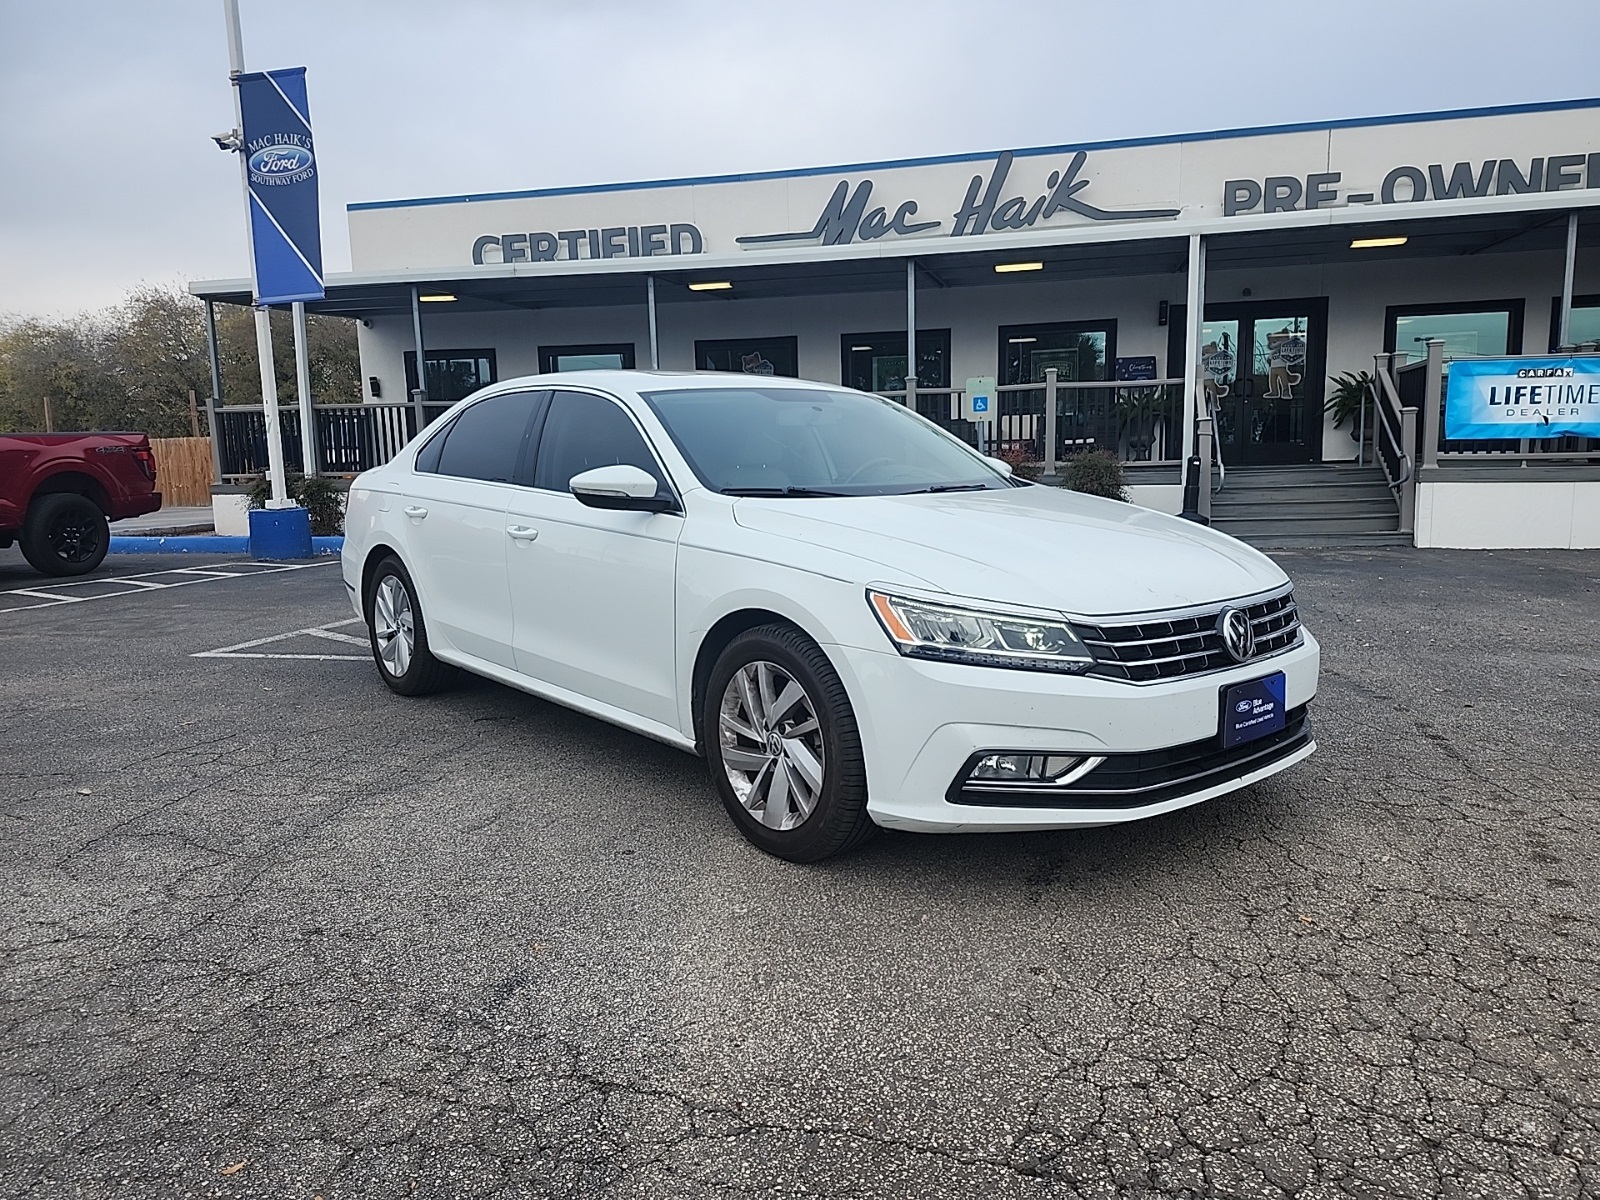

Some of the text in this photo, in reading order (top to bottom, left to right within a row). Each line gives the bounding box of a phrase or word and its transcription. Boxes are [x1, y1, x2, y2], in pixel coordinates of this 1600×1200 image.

[248, 133, 312, 153] MAC HAIK'S
[260, 150, 300, 172] Ford
[251, 168, 314, 186] SOUTHWAY FORD
[735, 150, 1181, 246] Mac Haik
[472, 223, 702, 265] CERTIFIED
[1517, 368, 1574, 378] CARFAX
[1489, 385, 1600, 406] LIFETIME
[1506, 408, 1580, 417] DEALER
